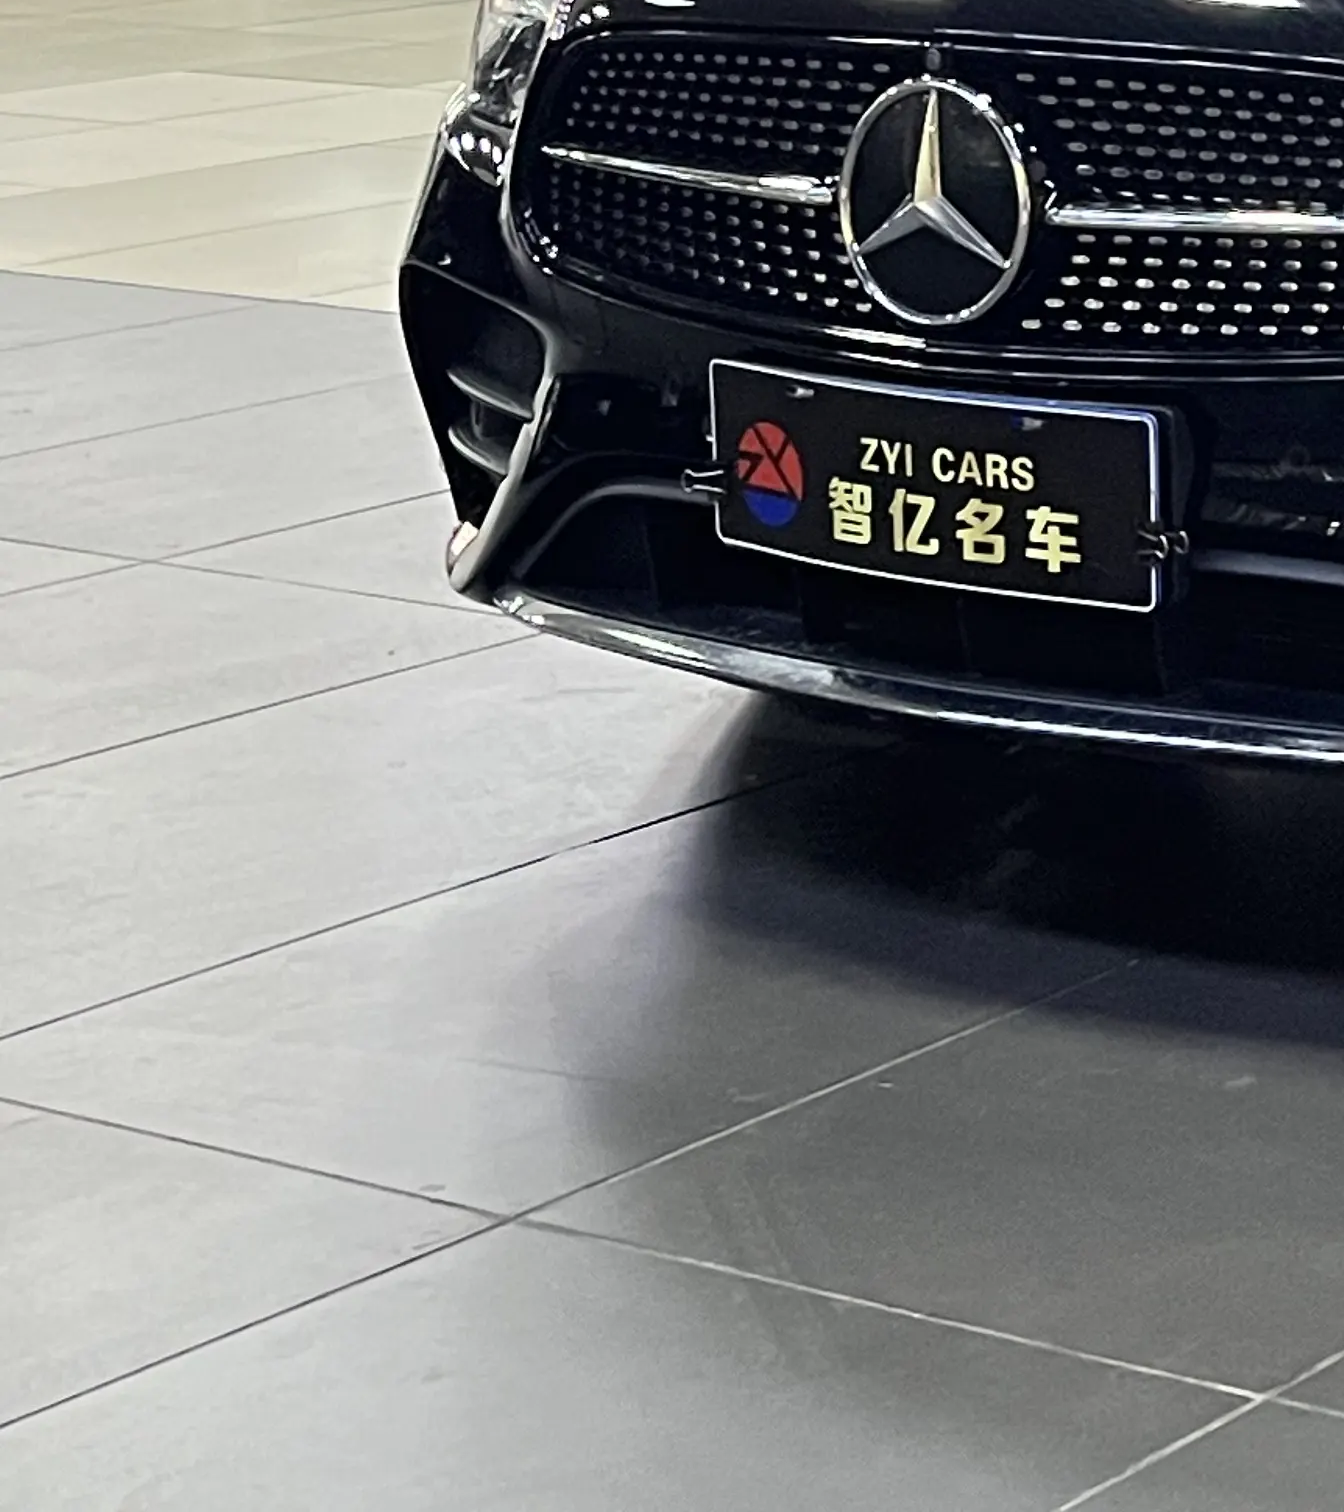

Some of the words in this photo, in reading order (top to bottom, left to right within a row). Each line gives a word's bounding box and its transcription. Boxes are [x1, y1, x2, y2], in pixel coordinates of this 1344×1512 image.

[860, 437, 913, 477] ZYI
[931, 447, 1035, 491] CARS
[828, 476, 1082, 573] 智亿名车
